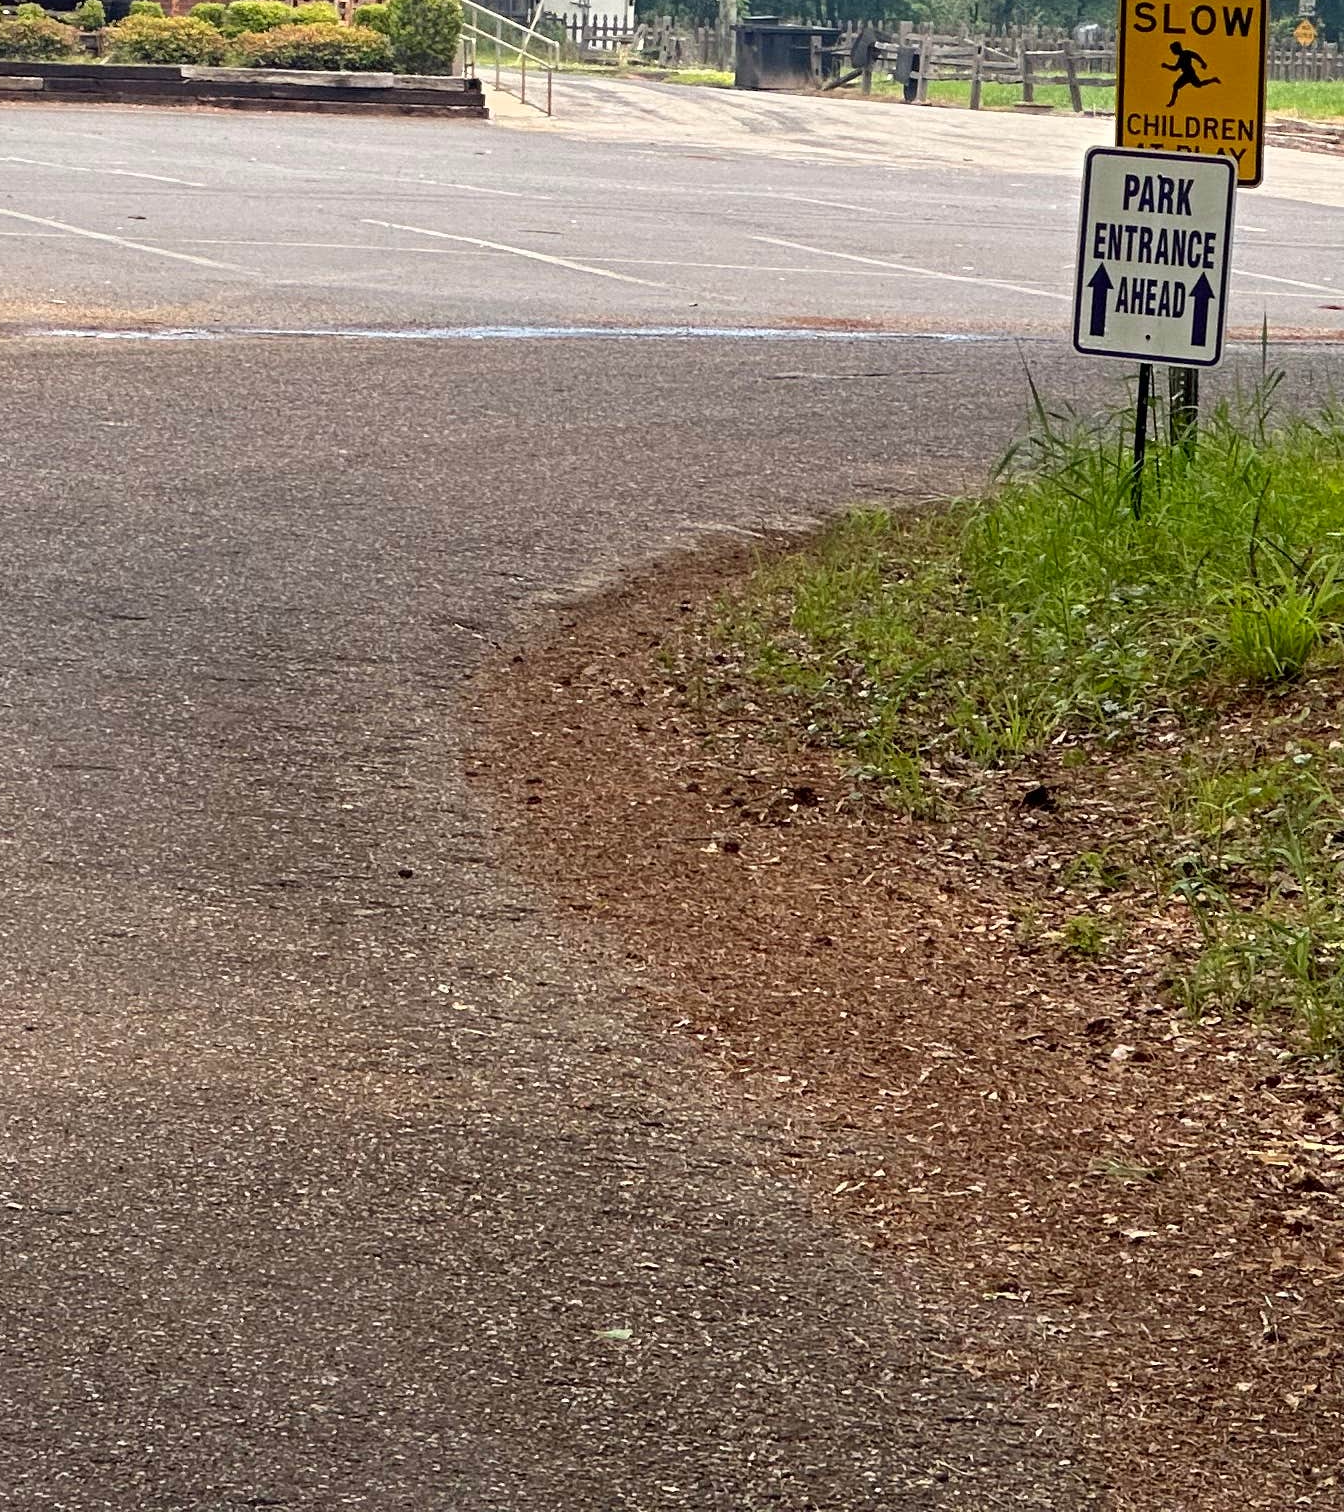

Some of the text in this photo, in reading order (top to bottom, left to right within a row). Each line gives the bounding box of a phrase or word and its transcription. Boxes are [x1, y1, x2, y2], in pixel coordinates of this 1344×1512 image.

[1133, 2, 1254, 37] SLOW
[1127, 113, 1254, 142] CHILDREN
[1123, 174, 1193, 217] PARK
[1093, 223, 1217, 270] ENTRANCE
[1115, 276, 1186, 319] AHEAD
